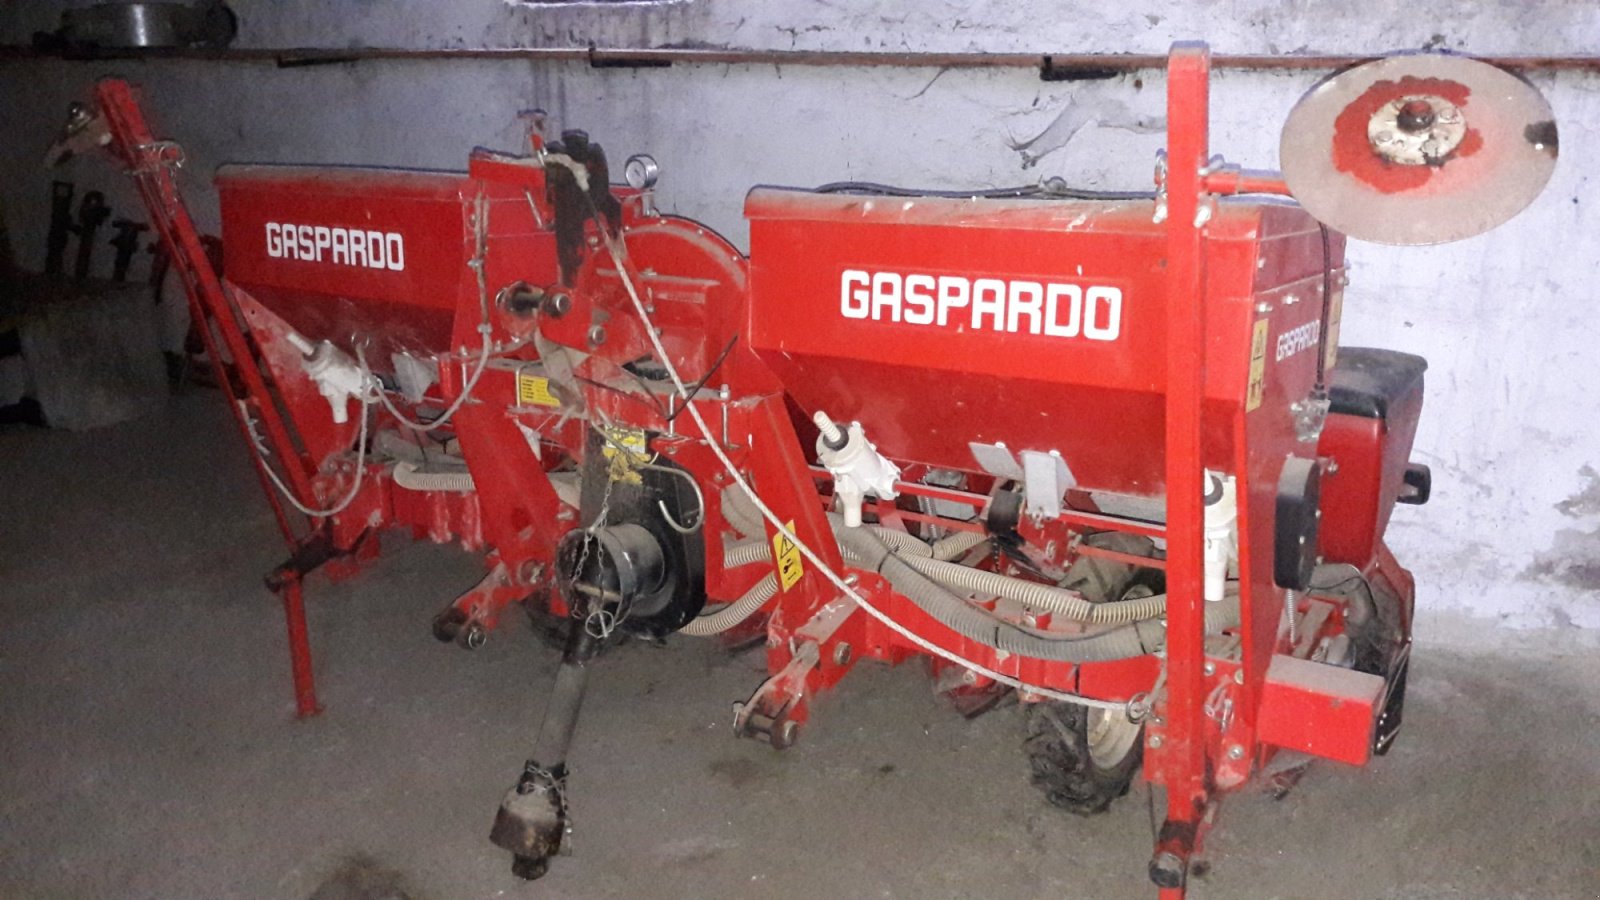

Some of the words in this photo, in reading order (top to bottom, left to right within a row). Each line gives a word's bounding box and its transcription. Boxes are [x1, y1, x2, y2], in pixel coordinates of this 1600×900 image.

[265, 222, 405, 271] GASPARDO
[840, 270, 1122, 341] GASPARDO
[1276, 319, 1320, 362] GASPARDO
